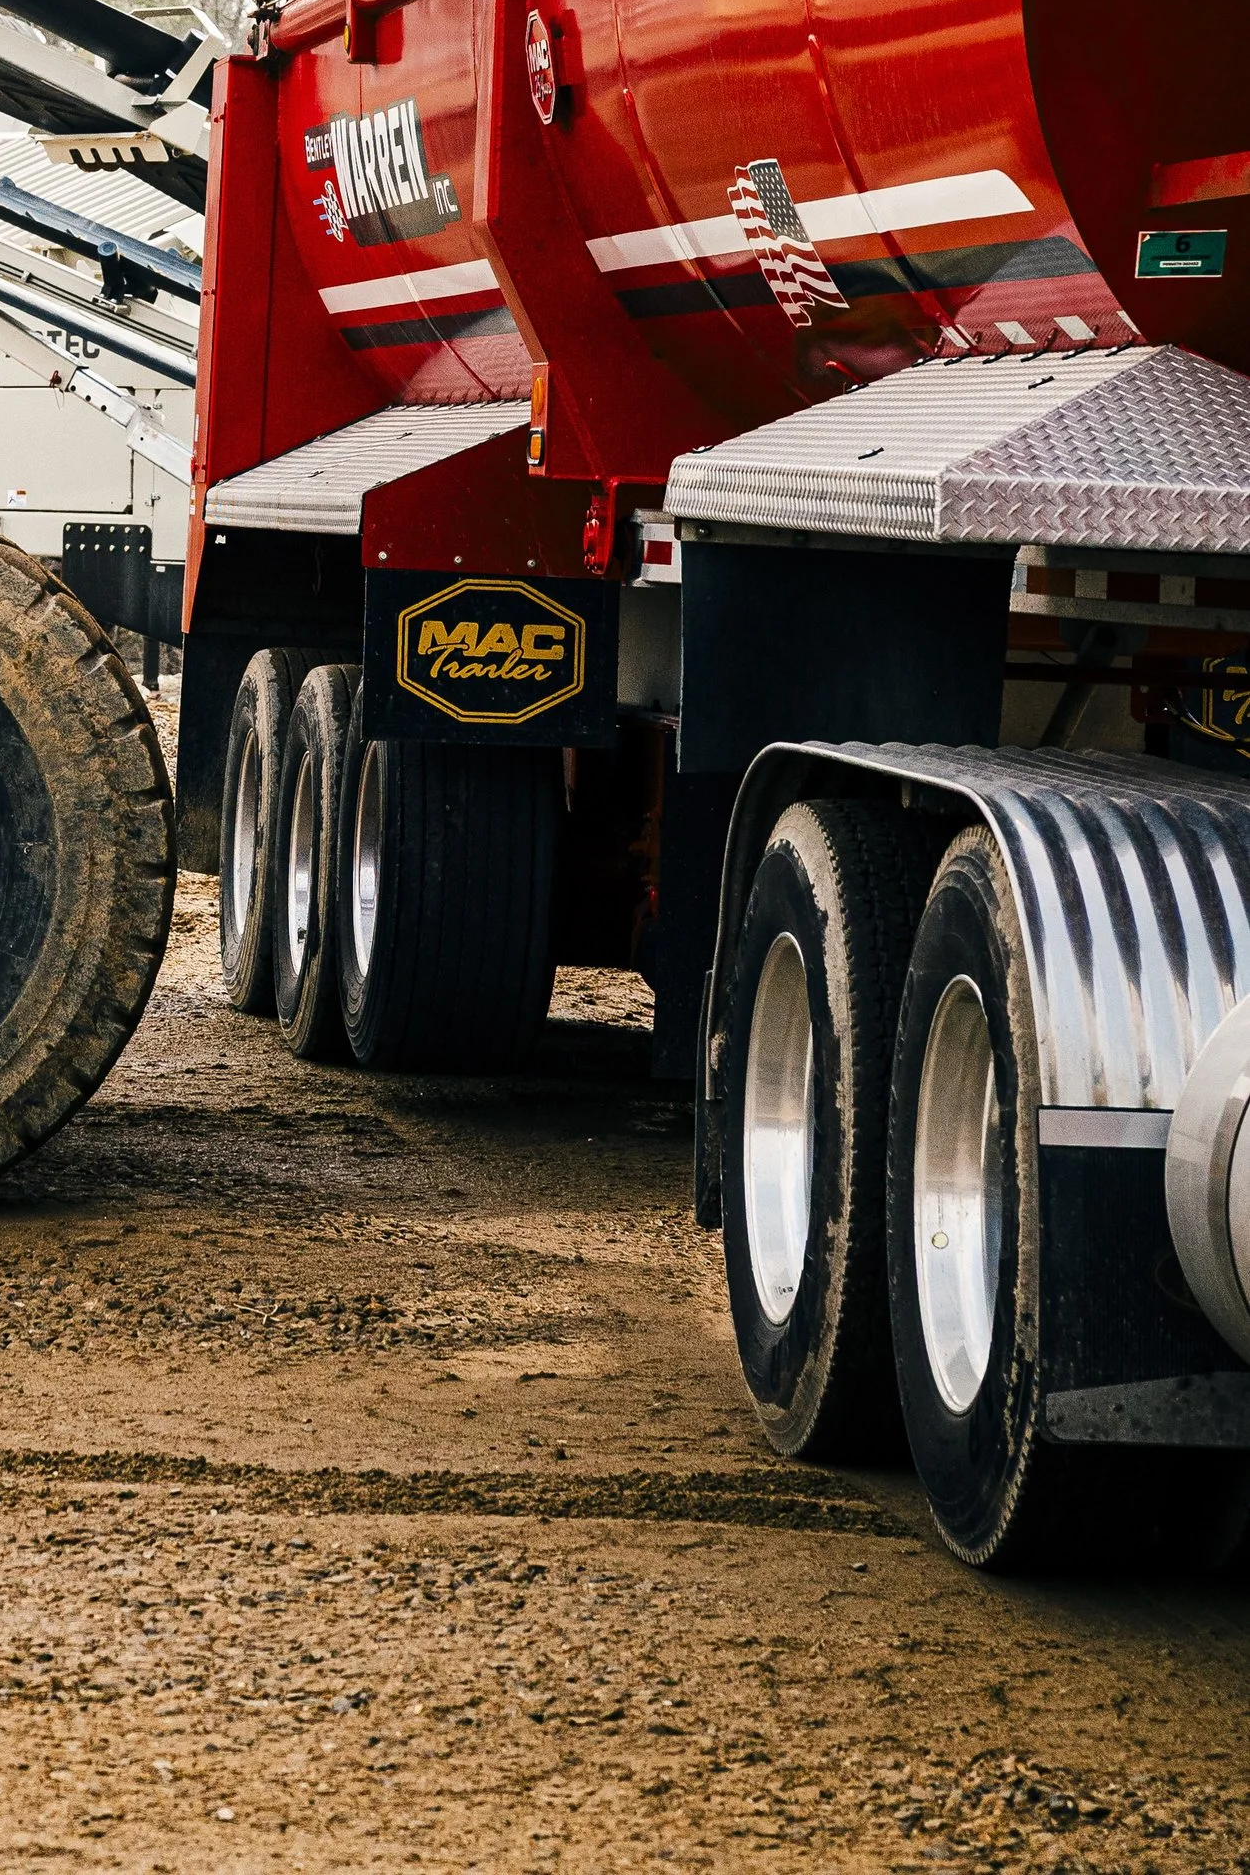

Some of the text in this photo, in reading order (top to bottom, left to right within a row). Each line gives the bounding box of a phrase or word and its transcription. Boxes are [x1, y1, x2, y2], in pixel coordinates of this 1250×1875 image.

[528, 39, 550, 74] MAC
[330, 100, 429, 219] WARREN
[1175, 235, 1190, 253] 6
[417, 620, 566, 660] MAC
[427, 642, 552, 681] Trailer
